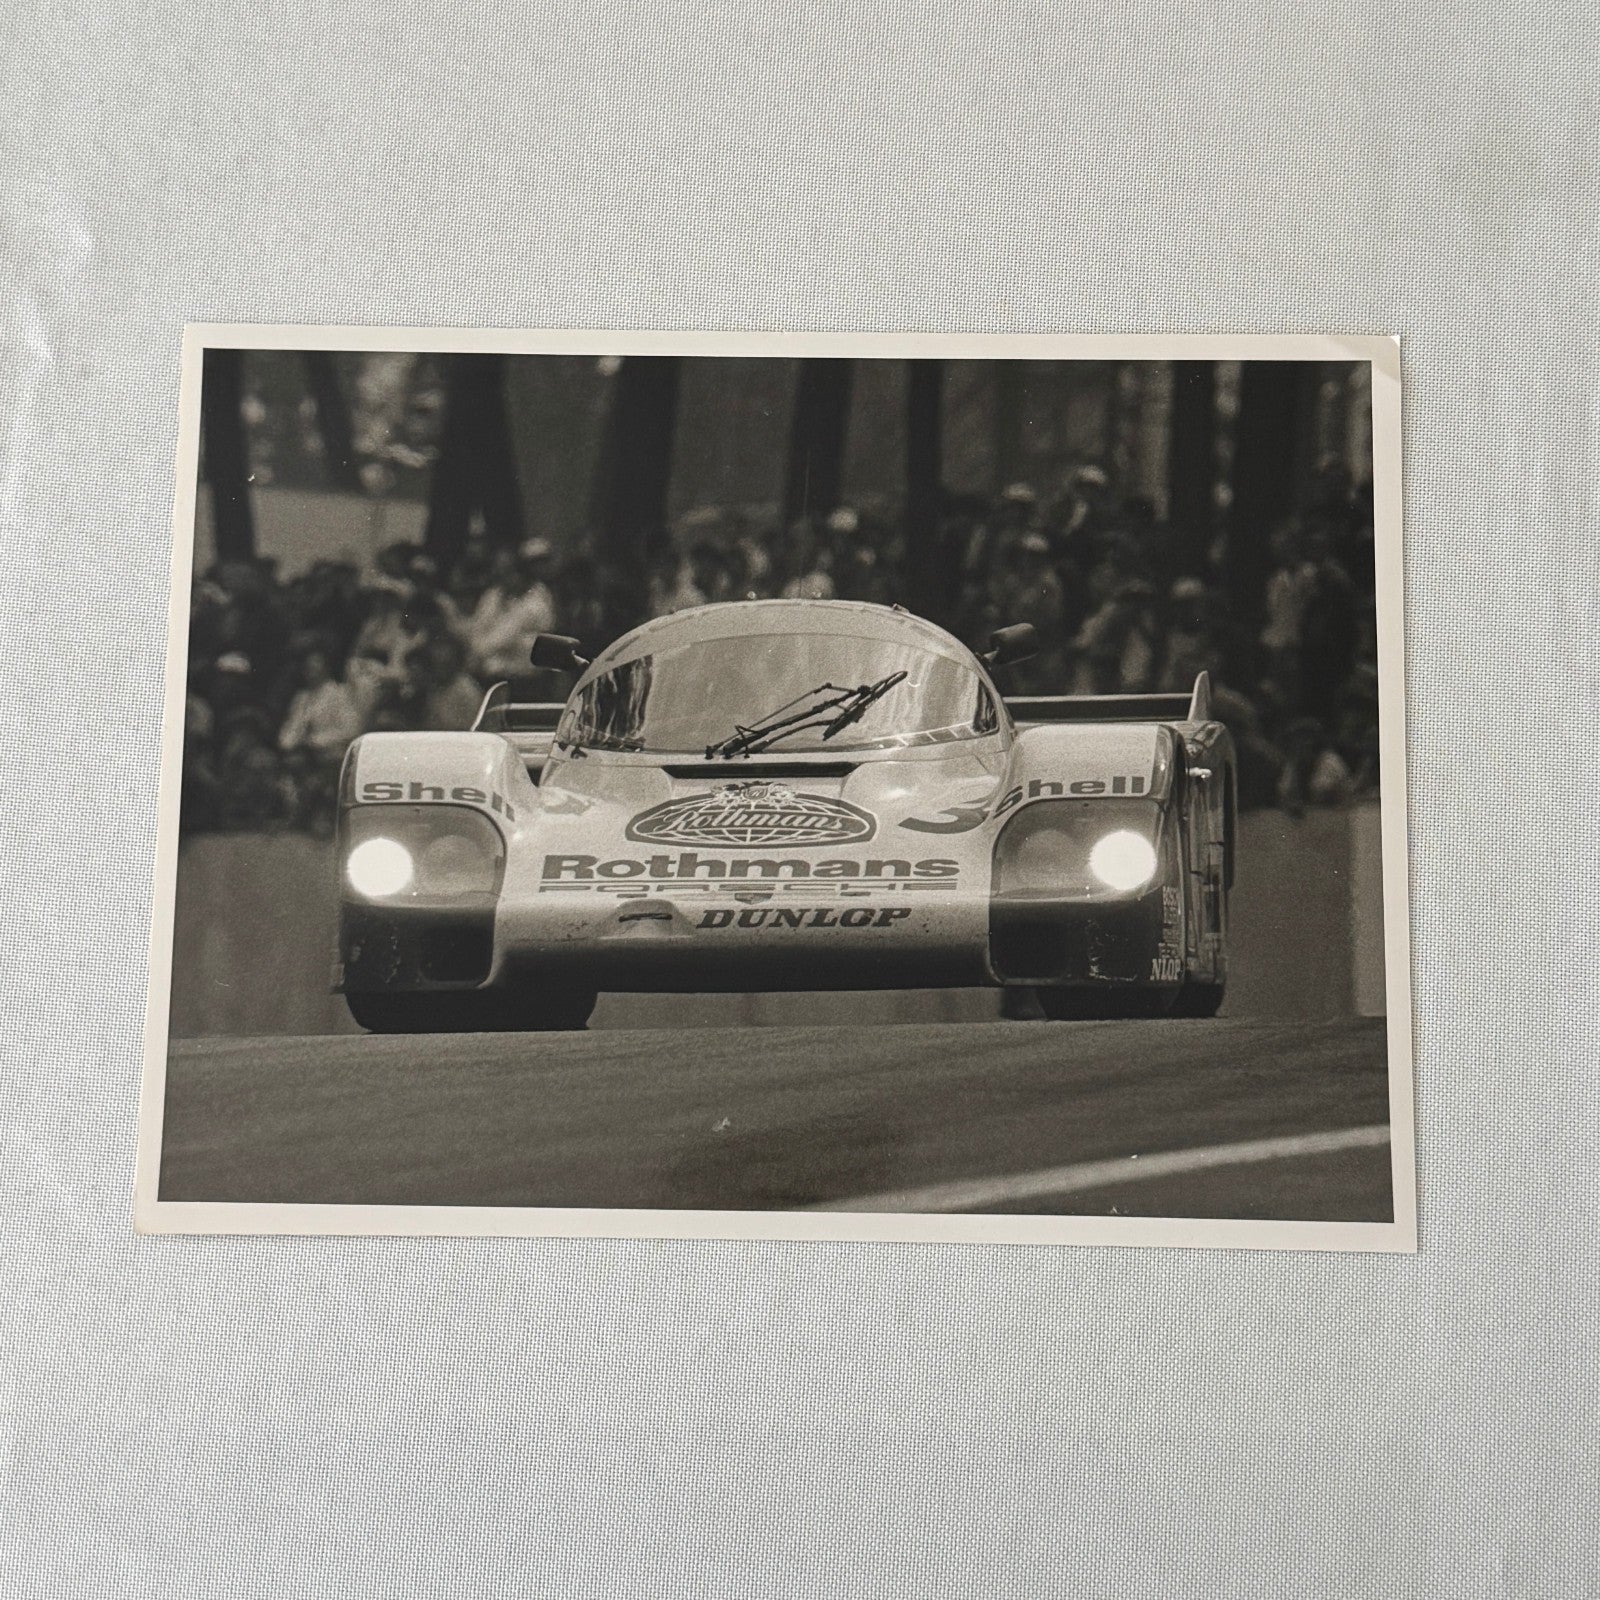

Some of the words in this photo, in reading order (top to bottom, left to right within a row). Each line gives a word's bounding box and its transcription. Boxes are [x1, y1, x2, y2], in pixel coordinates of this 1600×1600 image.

[362, 782, 515, 822] Shell
[993, 776, 1144, 819] Shell
[653, 808, 843, 832] Rothmans
[541, 853, 960, 880] Rothmans
[542, 882, 958, 894] PORSCHE
[696, 907, 913, 929] DUNLOP
